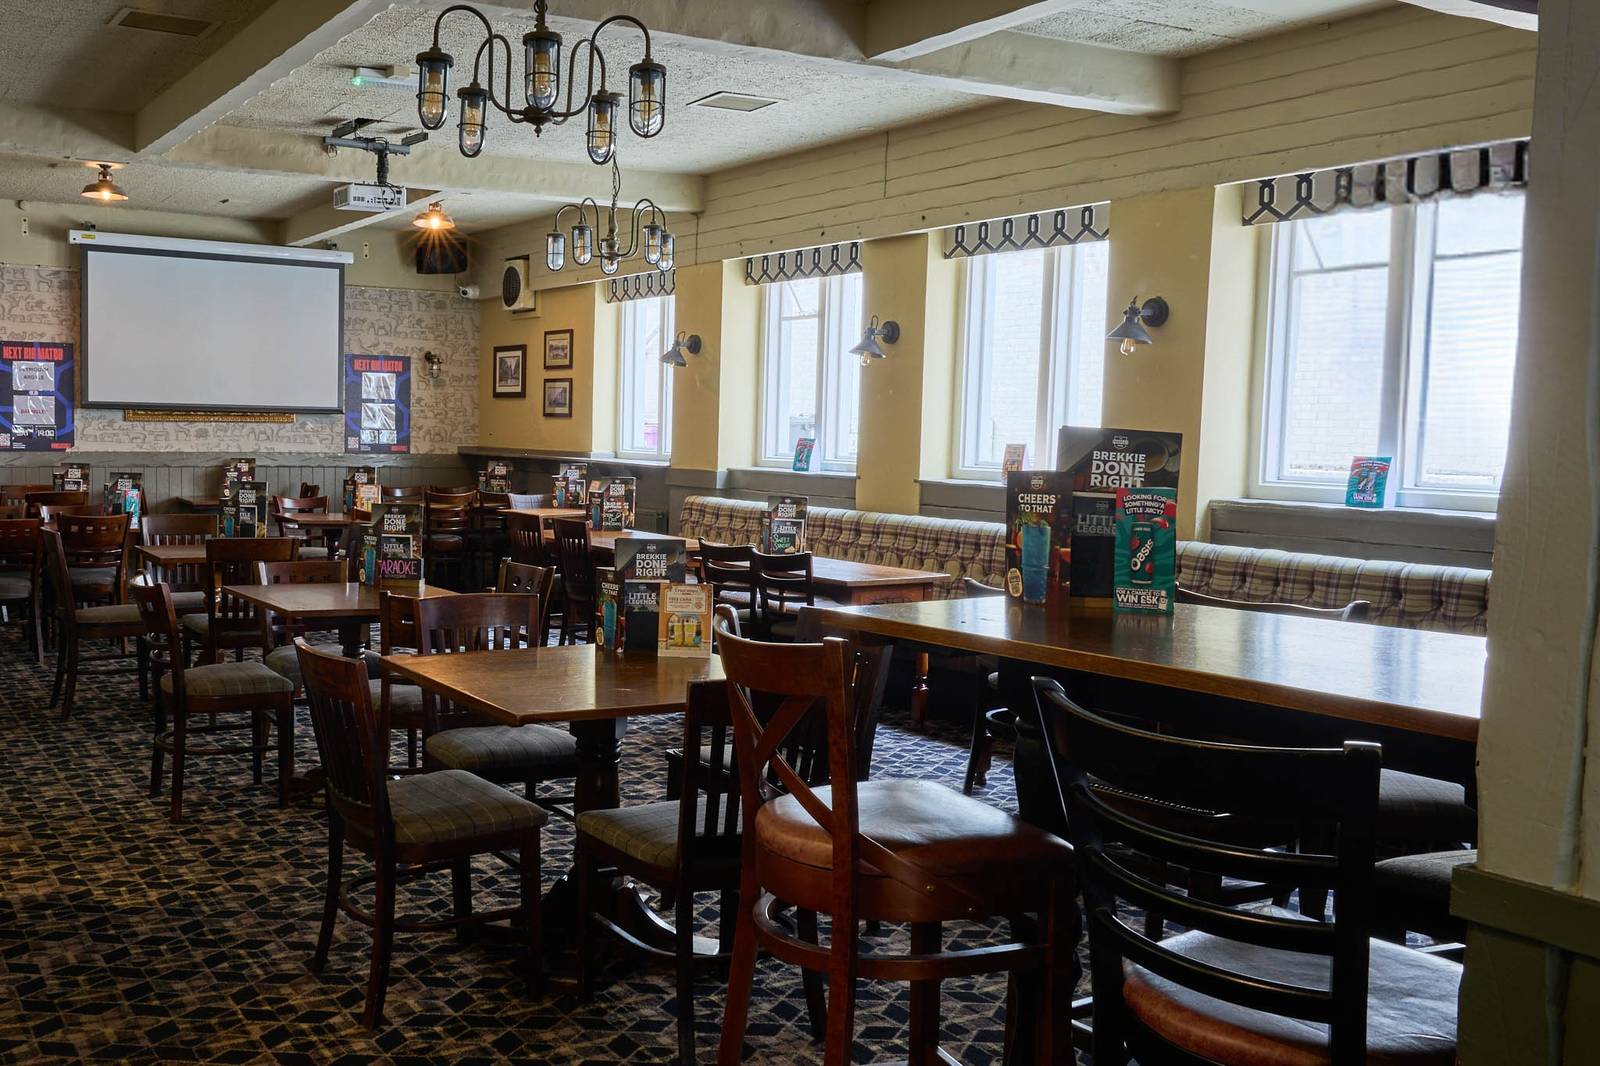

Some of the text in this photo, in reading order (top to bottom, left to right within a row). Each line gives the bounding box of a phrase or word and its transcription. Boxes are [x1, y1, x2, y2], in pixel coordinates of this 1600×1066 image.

[3, 346, 23, 359] NEXT
[1093, 450, 1147, 463] BREKKIE
[1091, 460, 1145, 477] DONE
[1089, 474, 1145, 488] RIGHT
[1018, 493, 1057, 505] CHEERS
[1123, 494, 1167, 503] LOOKING FOR
[1020, 504, 1054, 514] TO THAT
[1124, 500, 1159, 509] SOMETHING
[1126, 507, 1143, 515] LITTLE
[1078, 514, 1117, 526] LITTL
[384, 524, 407, 532] RIGHT
[1131, 538, 1154, 571] Oasis
[380, 560, 418, 575] ARAOKE
[636, 560, 667, 568] DONE
[635, 568, 667, 577] RIGHT
[601, 582, 619, 590] CHEERS
[628, 592, 657, 600] LITTLE
[1116, 592, 1159, 605] WIN £5K
